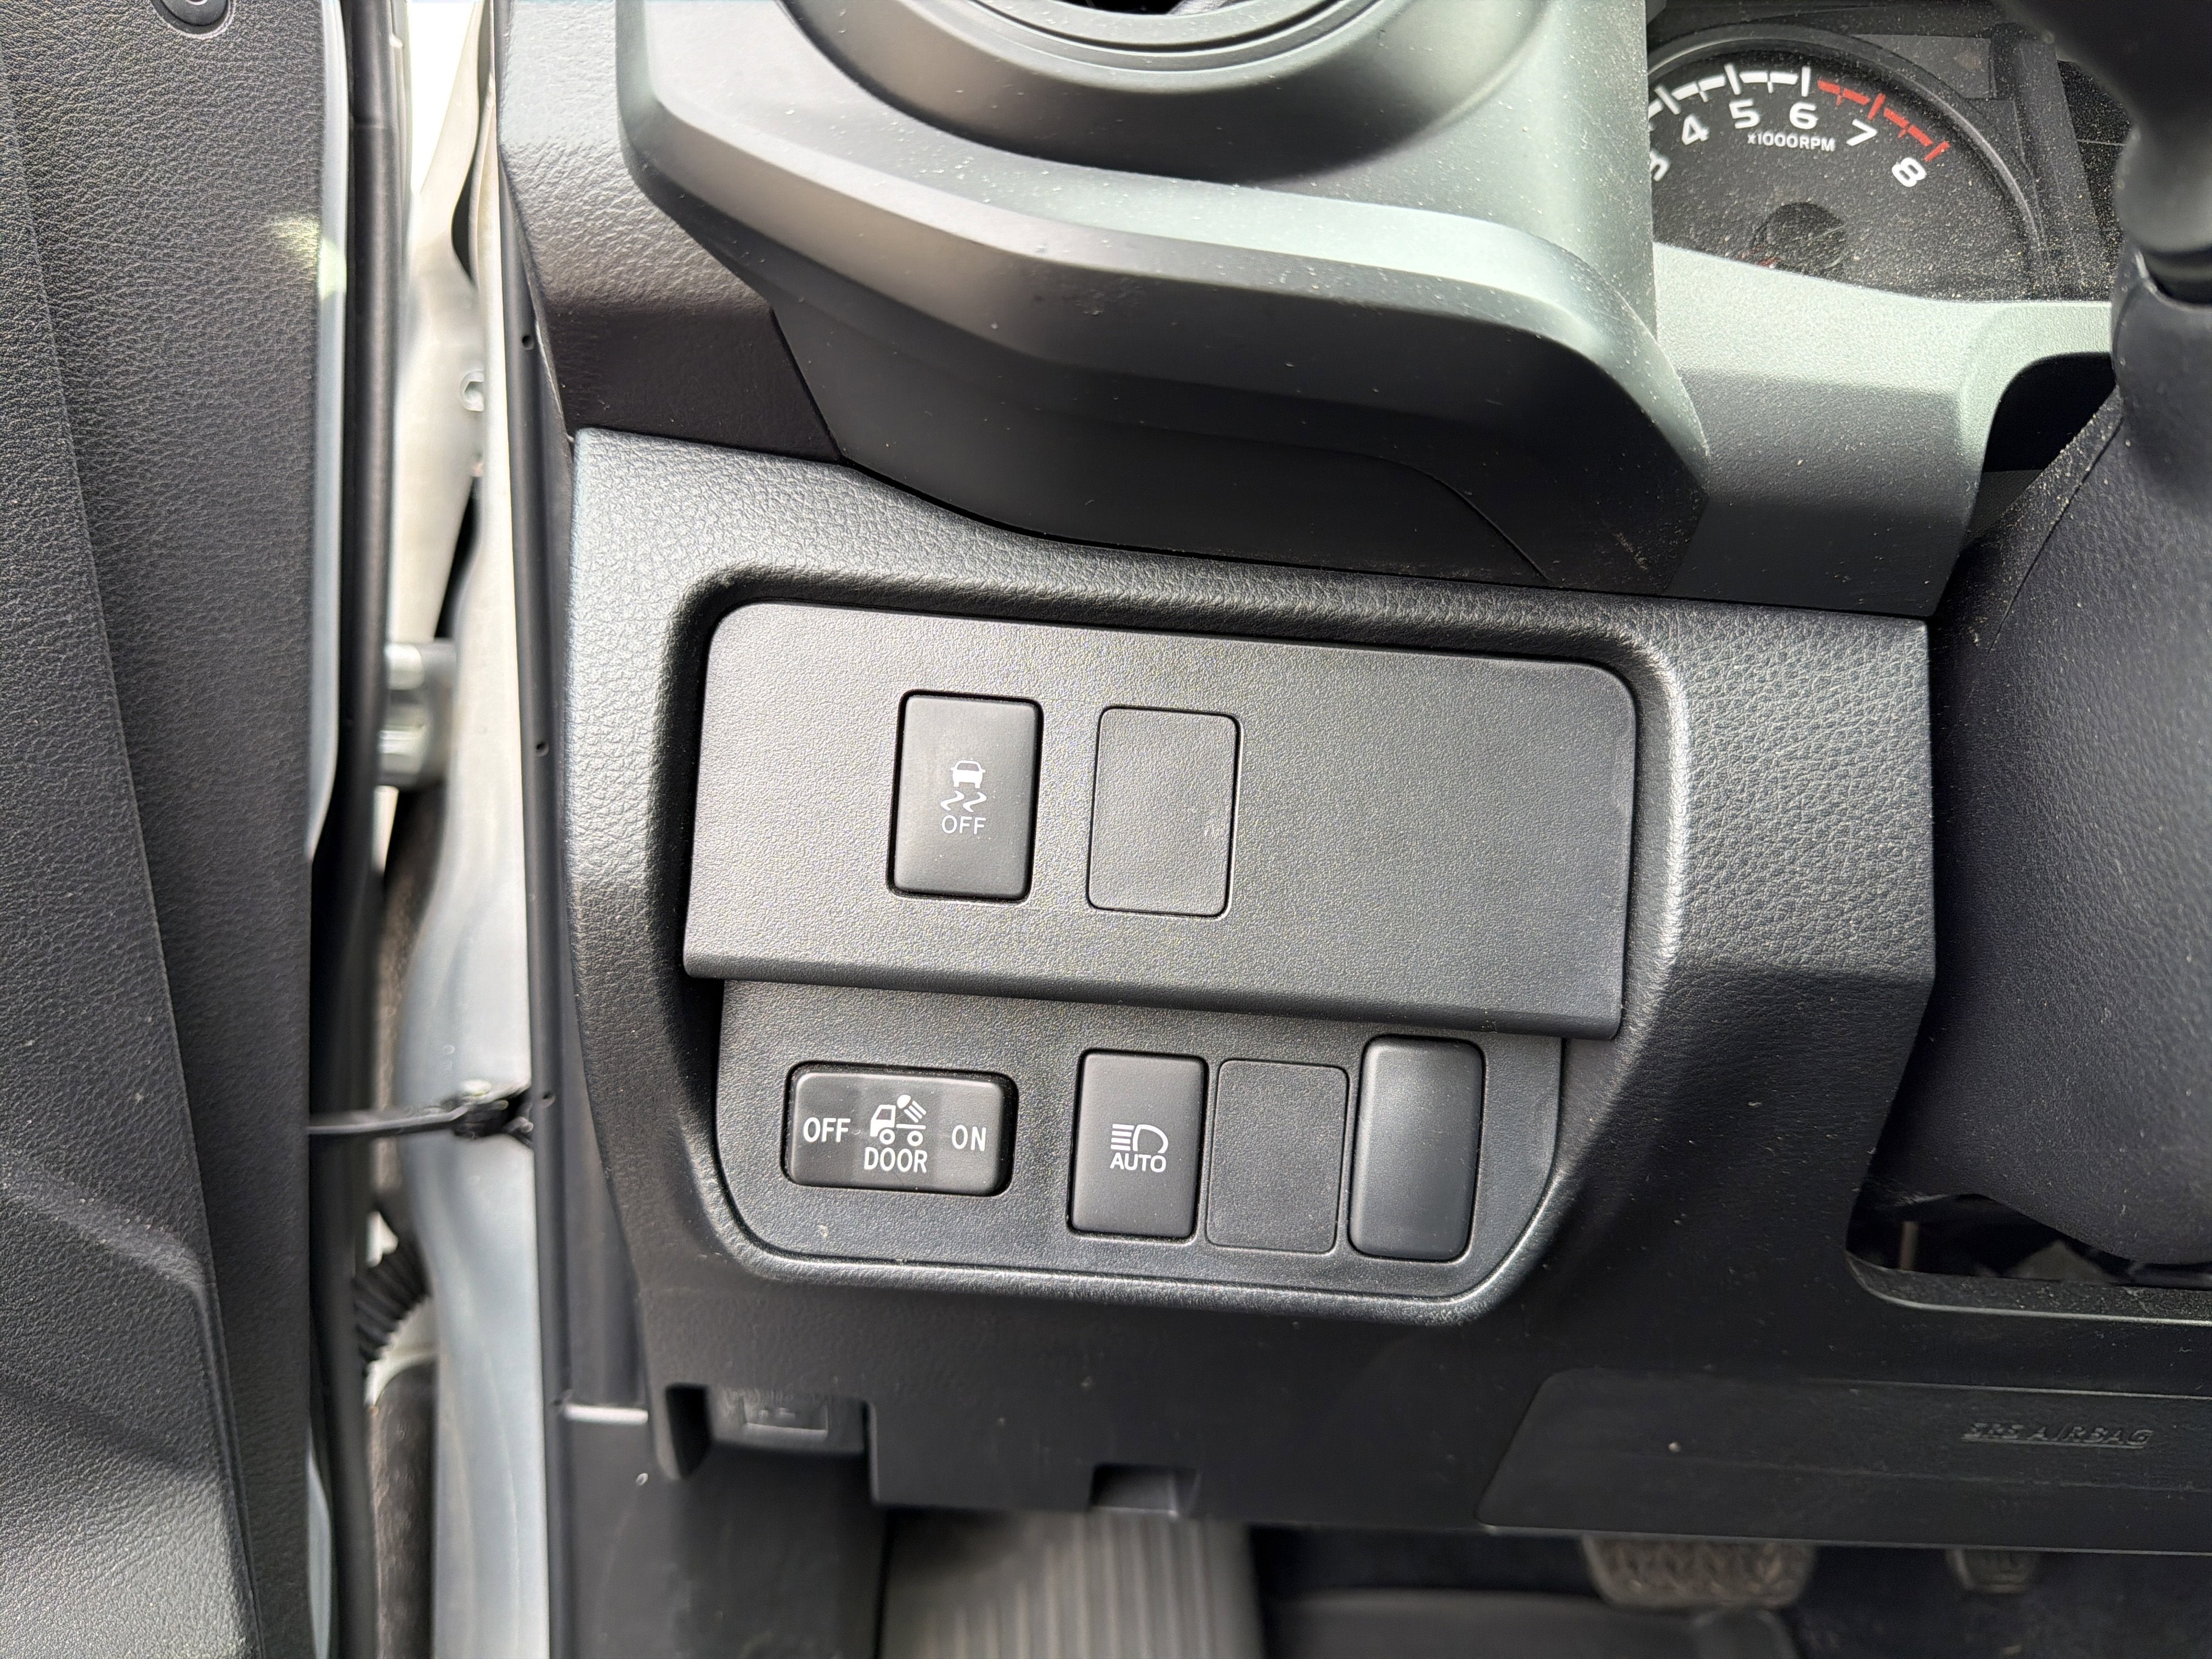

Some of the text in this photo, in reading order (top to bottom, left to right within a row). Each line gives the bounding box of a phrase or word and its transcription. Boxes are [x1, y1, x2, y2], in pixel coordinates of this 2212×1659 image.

[1681, 114, 1709, 145] 4
[1729, 98, 1760, 129] 5
[1788, 102, 1819, 130] 6
[1846, 119, 1878, 147] 7
[1891, 156, 1927, 188] 8
[941, 815, 986, 834] OFF
[803, 1117, 851, 1143] OFF
[951, 1125, 987, 1152] ON
[864, 1147, 928, 1173] DOOR
[1110, 1152, 1167, 1173] AUTO
